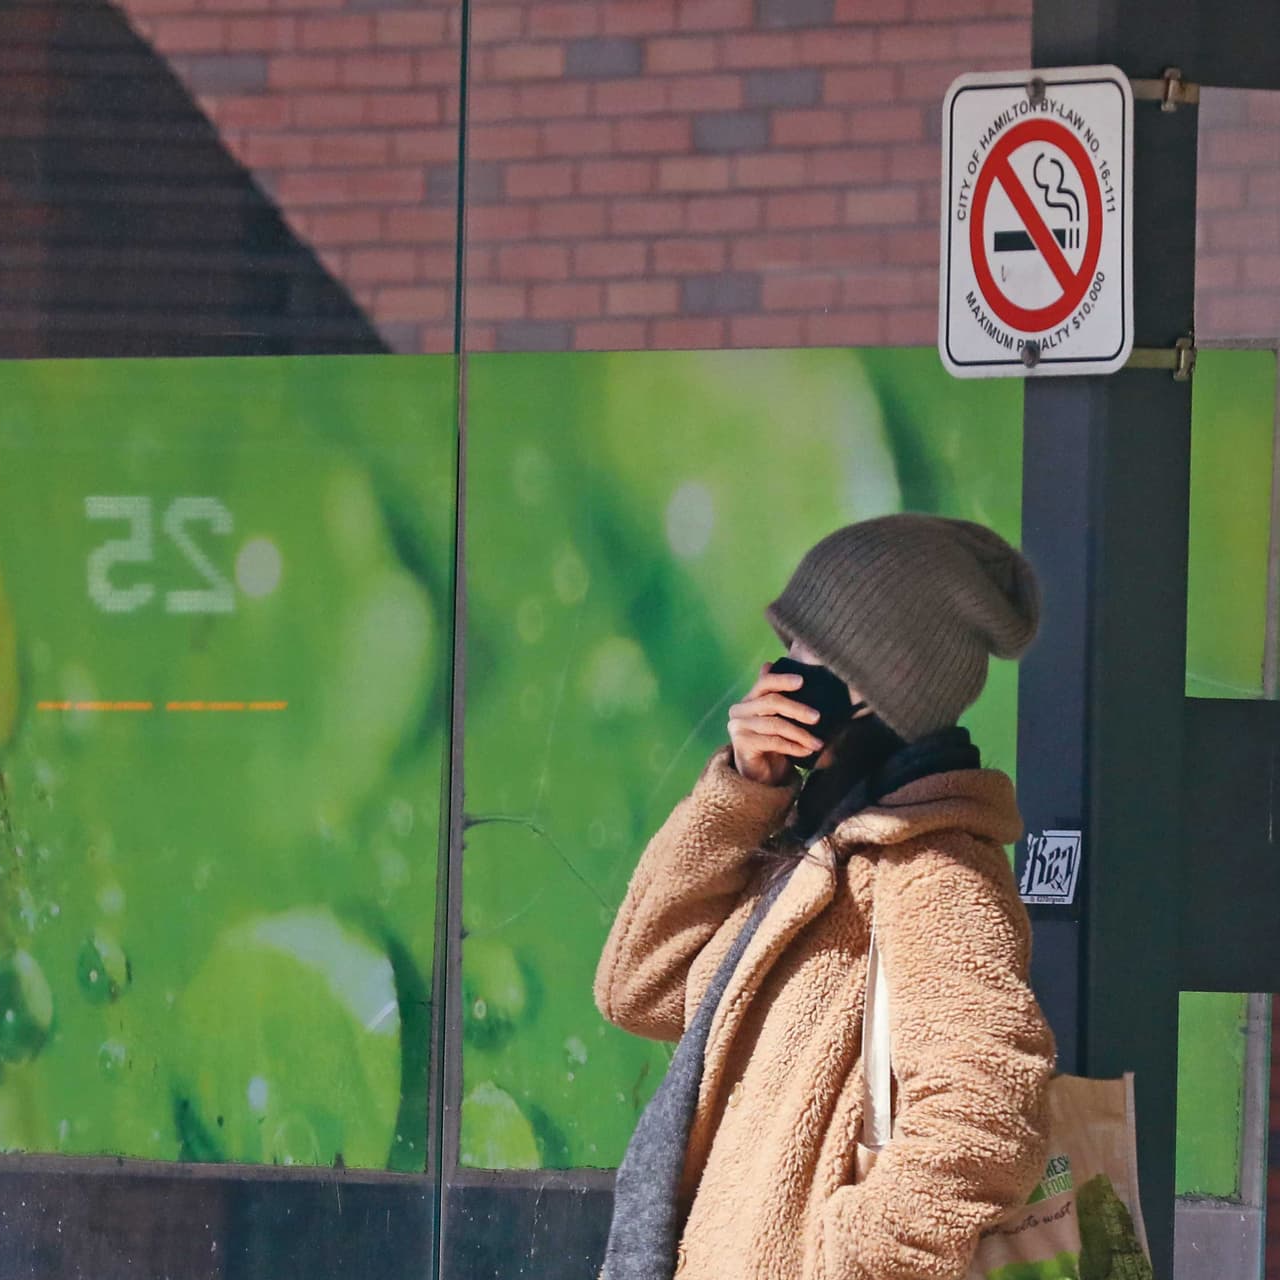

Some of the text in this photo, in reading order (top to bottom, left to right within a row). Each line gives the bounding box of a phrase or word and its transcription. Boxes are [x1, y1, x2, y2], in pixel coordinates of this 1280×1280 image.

[957, 99, 1116, 220] CITY OF HAMILTON BY-LAW NO. 16-111
[966, 271, 1105, 352] MAXIMUM PALTY $10,000
